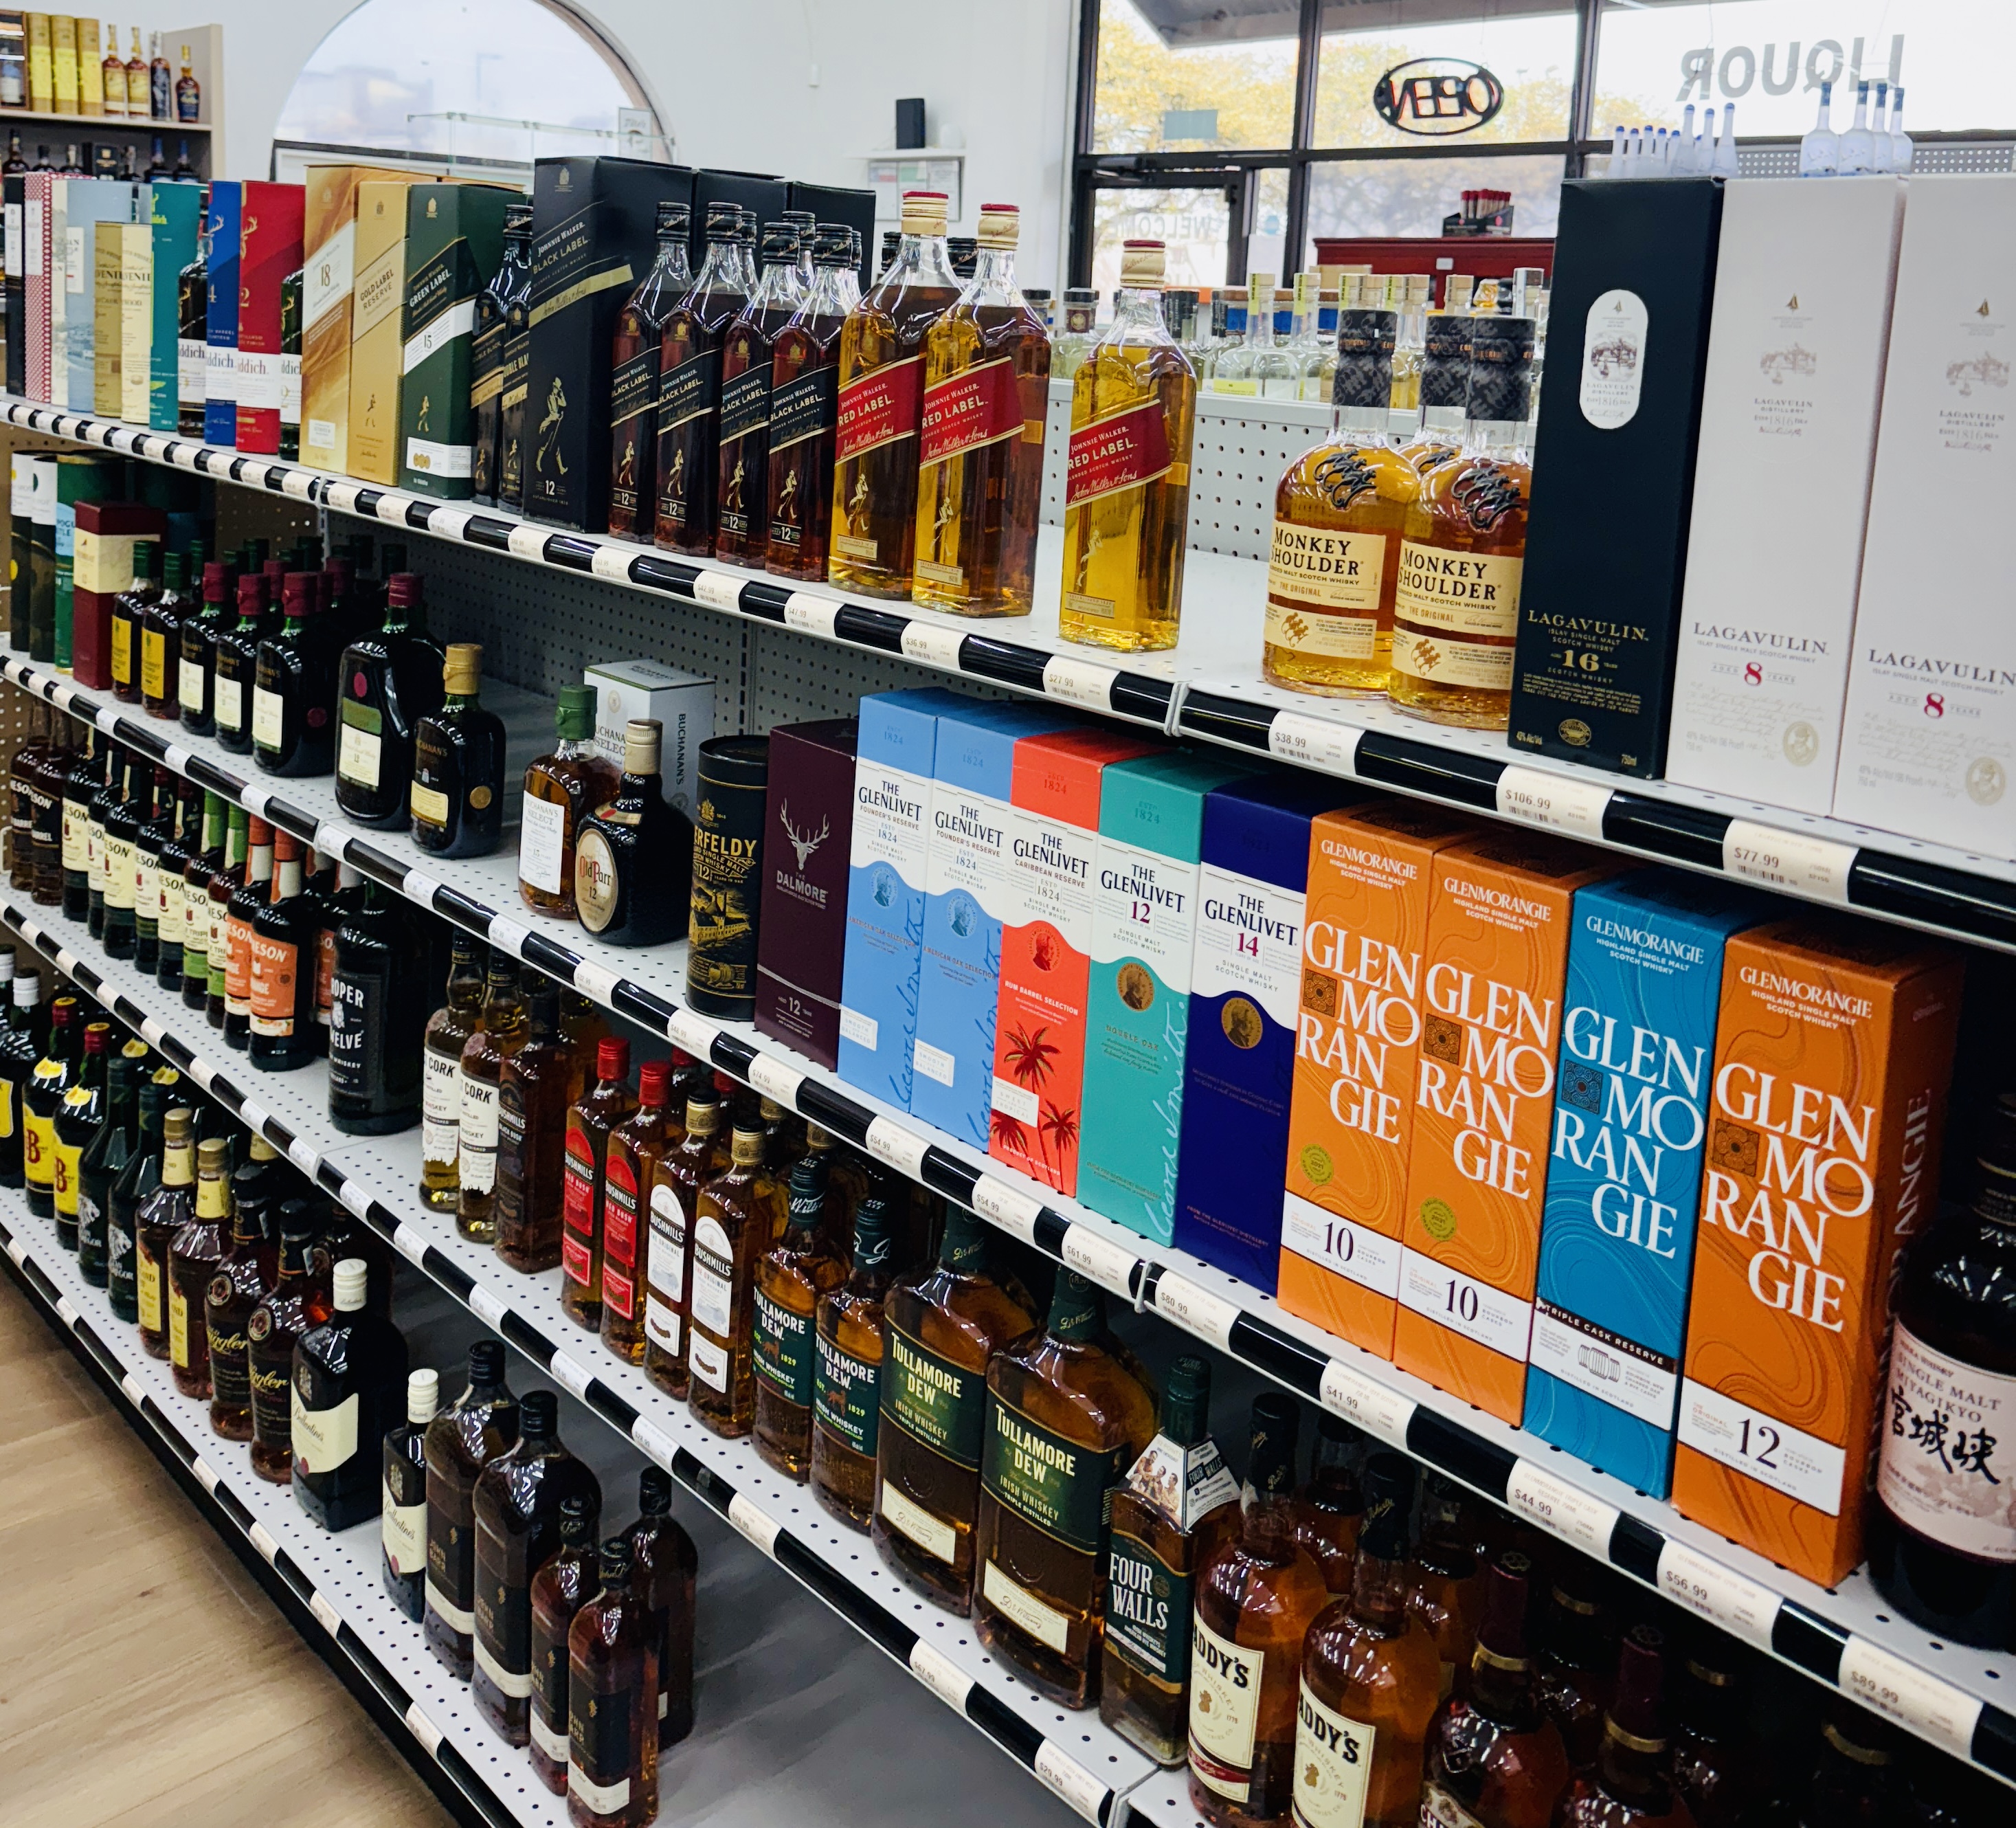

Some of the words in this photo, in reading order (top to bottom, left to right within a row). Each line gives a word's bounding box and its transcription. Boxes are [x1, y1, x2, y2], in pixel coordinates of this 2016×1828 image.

[533, 250, 558, 274] BLACK
[560, 236, 589, 257] LABEL
[537, 237, 561, 257] JOHNNIE
[320, 265, 331, 287] 18
[360, 285, 376, 302] GOLD
[376, 269, 394, 291] LABEL
[409, 285, 430, 307] GREEN
[430, 269, 451, 291] LABEL
[363, 282, 392, 310] RESERVE
[423, 334, 432, 349] 15
[838, 409, 855, 427] RED
[858, 394, 893, 417] LABEL
[922, 410, 942, 430] RED
[945, 395, 985, 419] LABEL
[1754, 397, 1813, 409] LAGAVULIN
[1940, 410, 2005, 423] LAGAVULIN
[545, 480, 556, 495] 12
[620, 491, 629, 505] 12
[668, 502, 678, 516] 12
[729, 515, 739, 530] 12
[781, 526, 792, 542] 12
[1274, 526, 1352, 557] MONKEY
[1403, 548, 1488, 580] MONKEY
[1279, 581, 1289, 592] THE
[1290, 583, 1321, 598] ORIGINAL
[1399, 566, 1497, 601] SHOULDER
[1409, 605, 1419, 616] THE
[1420, 608, 1455, 624] ORIGINAL
[1528, 610, 1646, 641] LAGAVULIN
[905, 637, 928, 650] $36.99
[1548, 628, 1569, 638] ISLAY
[1571, 632, 1596, 642] SINGLE
[1600, 636, 1621, 646] MALT
[1693, 622, 1828, 655] LAGAVULIN
[1562, 649, 1600, 672] 16
[1868, 649, 2016, 686] LAGAVULIN
[1048, 673, 1074, 688] $27.99
[1924, 692, 1945, 720] 8
[676, 713, 686, 785] BUCHANAN'S
[1275, 732, 1306, 748] $38.99
[882, 780, 900, 796] THE
[1044, 779, 1066, 794] 1824
[1505, 789, 1552, 810] $106.99
[526, 798, 558, 818] BUCHANAN'S
[527, 808, 554, 826] SELECT
[859, 787, 922, 821] GLENLIVET
[860, 805, 891, 821] FOUNDER'S
[893, 816, 919, 831] RESERVE
[960, 804, 980, 821] THE
[1134, 807, 1160, 825] 1824
[878, 829, 897, 844] 1824
[935, 811, 1004, 848] GLENLIVET
[937, 829, 970, 847] FOUNDER'S
[972, 842, 1000, 858] RESERVE
[1041, 832, 1062, 850] THE
[580, 856, 592, 878] Old
[592, 861, 611, 886] Parr
[697, 865, 710, 881] 12
[704, 857, 730, 873] WHISKY
[956, 856, 976, 870] 1824
[1013, 838, 1089, 878] GLENLIVET
[1321, 839, 1418, 880] GLENMORANGIE
[1329, 858, 1362, 873] HIGHLAND
[1363, 869, 1387, 881] SINGLE
[1387, 876, 1407, 887] MALT
[1734, 847, 1780, 869] $77.99
[776, 871, 828, 903] DALMORE
[1015, 859, 1052, 878] CARIBBEAN
[1055, 873, 1086, 889] RESERVE
[1132, 864, 1155, 883] THE
[589, 887, 597, 900] 12
[1037, 886, 1060, 902] 1824
[1101, 870, 1185, 913] GLENLIVET
[1238, 893, 1264, 914] THE
[1444, 876, 1552, 922] GLENMORANGIE
[1130, 901, 1151, 924] 12
[1205, 900, 1298, 946] GLENLIVET
[1453, 898, 1490, 915] HIGHLAND
[1491, 909, 1516, 922] SINGLE
[1518, 917, 1539, 929] MALT
[1119, 928, 1142, 941] SINGLE
[1145, 936, 1161, 947] MALT
[1237, 933, 1259, 957] 14
[1586, 915, 1704, 966] GLENMORANGIE
[1305, 921, 1422, 1001] GLEN
[789, 997, 800, 1016] 12
[1005, 980, 1018, 990] RUM
[1019, 986, 1043, 1001] BARREL
[1044, 994, 1078, 1016] SELECTION
[1425, 963, 1556, 1049] GLEN
[1739, 966, 1873, 1019] GLENMORANGIE
[1336, 980, 1421, 1047] MO
[1297, 1012, 1389, 1089] RAN
[1464, 1026, 1554, 1098] MO
[1564, 1007, 1707, 1099] GLEN
[429, 1057, 456, 1078] CORK
[752, 1069, 771, 1084] $74.99
[465, 1082, 493, 1104] CORK
[1416, 1059, 1519, 1142] RAN
[1330, 1078, 1401, 1145] GIE
[1602, 1073, 1705, 1152] MO
[1715, 1062, 1875, 1162] GLEN
[870, 1133, 891, 1151] $54.99
[1552, 1107, 1664, 1199] RAN
[565, 1152, 593, 1180] BUSHMILLS
[1453, 1129, 1532, 1201] GIE
[1760, 1133, 1874, 1218] MO
[606, 1181, 636, 1210] BUSHMILLS
[976, 1194, 999, 1212] $54.99
[651, 1211, 684, 1243] BUSHMILLS
[1591, 1183, 1678, 1259] GIE
[1703, 1170, 1829, 1267] RAN
[1067, 1245, 1092, 1264] $61.99
[1323, 1221, 1354, 1262] 10
[695, 1245, 732, 1277] BUSHMILLS
[1161, 1293, 1187, 1315] $80.99
[1446, 1280, 1478, 1322] 10
[1748, 1249, 1846, 1333] GIE
[754, 1286, 805, 1335] TULLAMORE
[761, 1313, 784, 1341] D.E.W.
[1546, 1306, 1580, 1326] TRIPLE
[1584, 1324, 1611, 1341] CASK
[1615, 1338, 1664, 1365] RESERVE
[781, 1354, 796, 1366] 1829
[816, 1333, 875, 1384] TULLAMORE
[891, 1332, 962, 1398] TULLAMORE
[826, 1361, 851, 1390] D.E.W.
[907, 1372, 936, 1405] DEW
[849, 1404, 865, 1416] 1829
[1325, 1385, 1358, 1409] $41.99
[1897, 1367, 1982, 1423] MIYAGIKYO
[996, 1404, 1076, 1477] TULLAMORE
[1738, 1418, 1780, 1469] 12
[1014, 1447, 1046, 1484] DEW
[1189, 1468, 1205, 1487] FOUR
[1205, 1456, 1223, 1480] WALLS
[1514, 1489, 1552, 1516] $44.99
[1109, 1552, 1153, 1596] FOUR
[1666, 1571, 1708, 1601] $56.99
[1112, 1583, 1168, 1631] WALLS
[1850, 1671, 1899, 1704] $89.99
